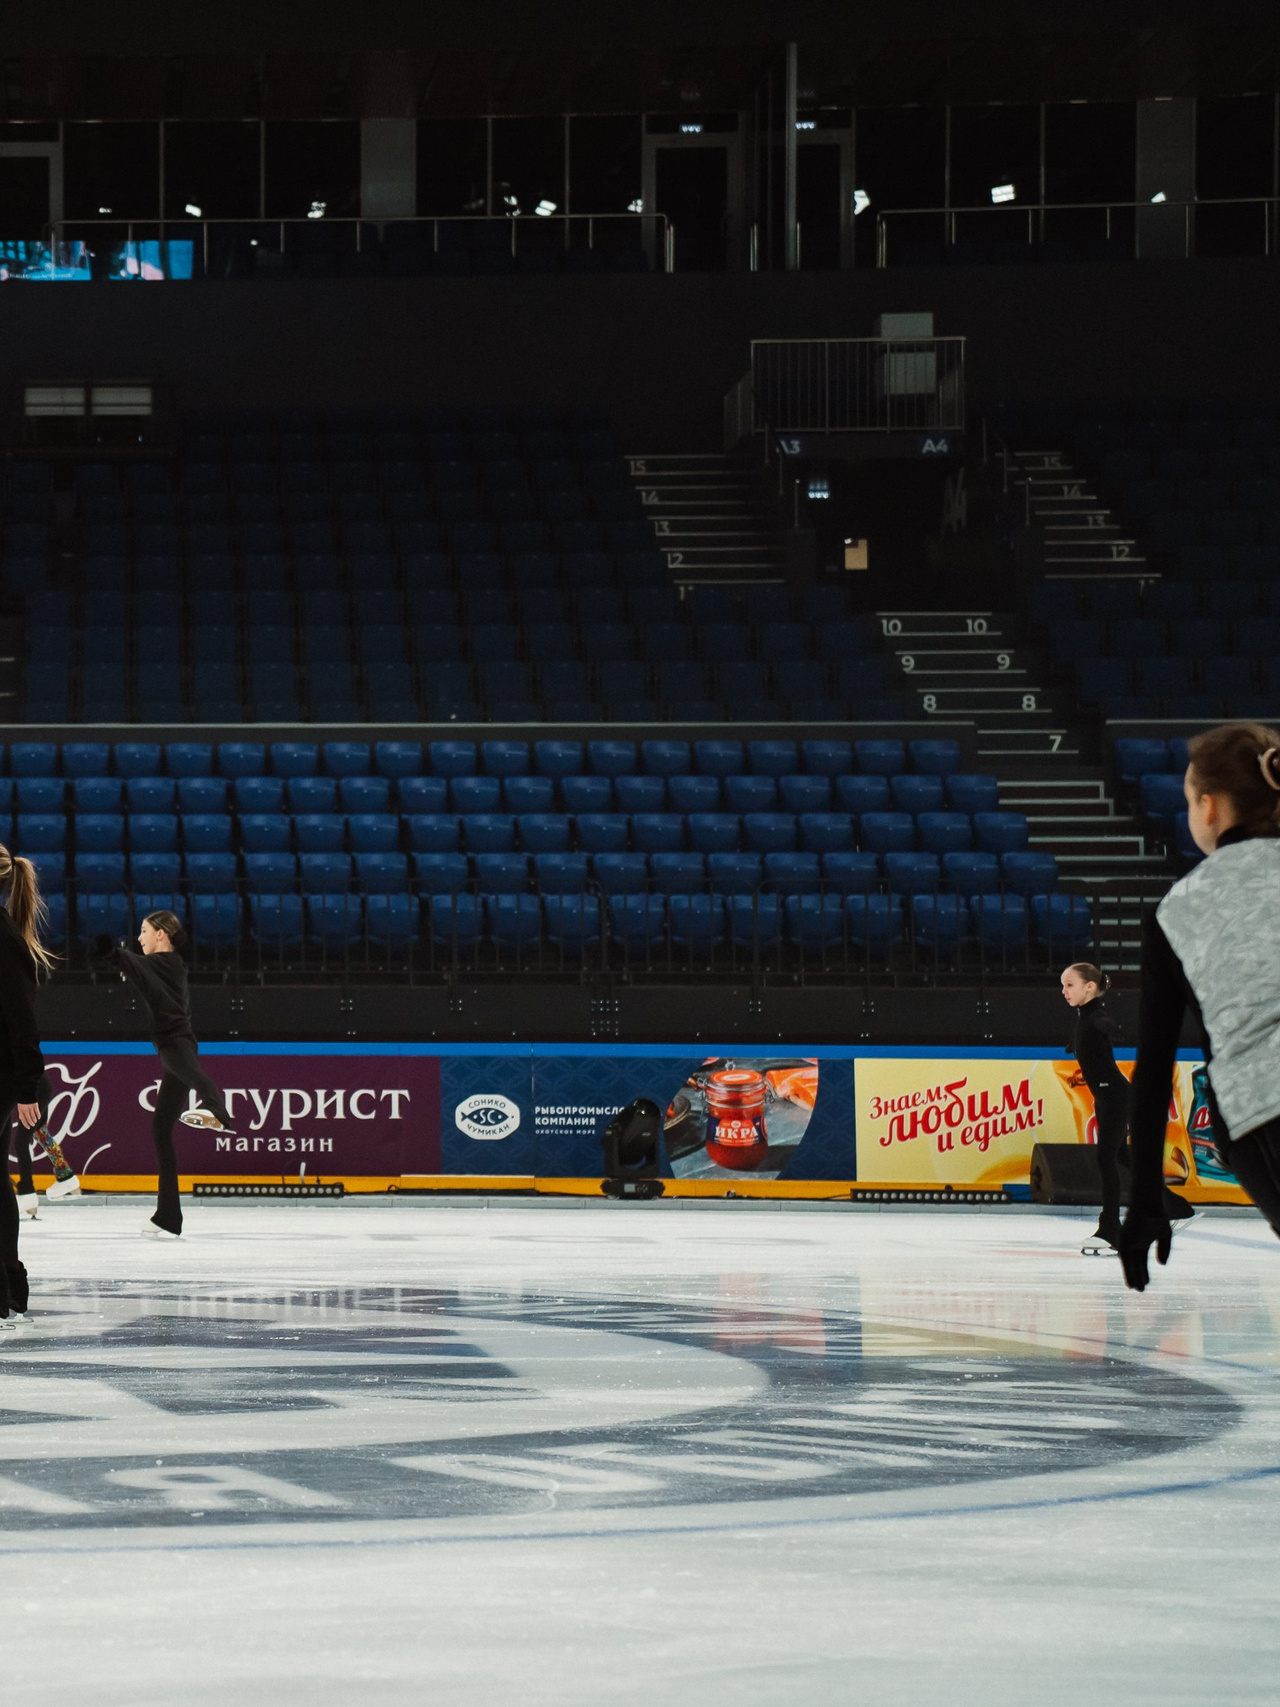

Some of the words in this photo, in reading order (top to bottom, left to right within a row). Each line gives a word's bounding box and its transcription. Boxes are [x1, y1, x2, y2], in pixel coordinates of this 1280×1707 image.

[922, 438, 948, 454] A4
[1111, 546, 1129, 561] 12
[881, 618, 902, 636] 10
[966, 618, 987, 635] 10
[901, 655, 915, 672] 9
[996, 653, 1010, 671] 9
[922, 694, 937, 712] 8
[1022, 694, 1037, 712] 8
[1048, 734, 1062, 752] 7
[138, 1079, 410, 1131] гурист
[468, 1099, 506, 1109] СОНИКО
[870, 1085, 948, 1120] Знаем,
[879, 1076, 1033, 1147] любим
[467, 1123, 511, 1136] ЧУМИКАН
[535, 1117, 596, 1126] КОМПАНИЯ
[937, 1131, 955, 1153] и
[960, 1098, 1044, 1153] едим!
[714, 1126, 760, 1139] ИКРА
[215, 1136, 333, 1153] магазин
